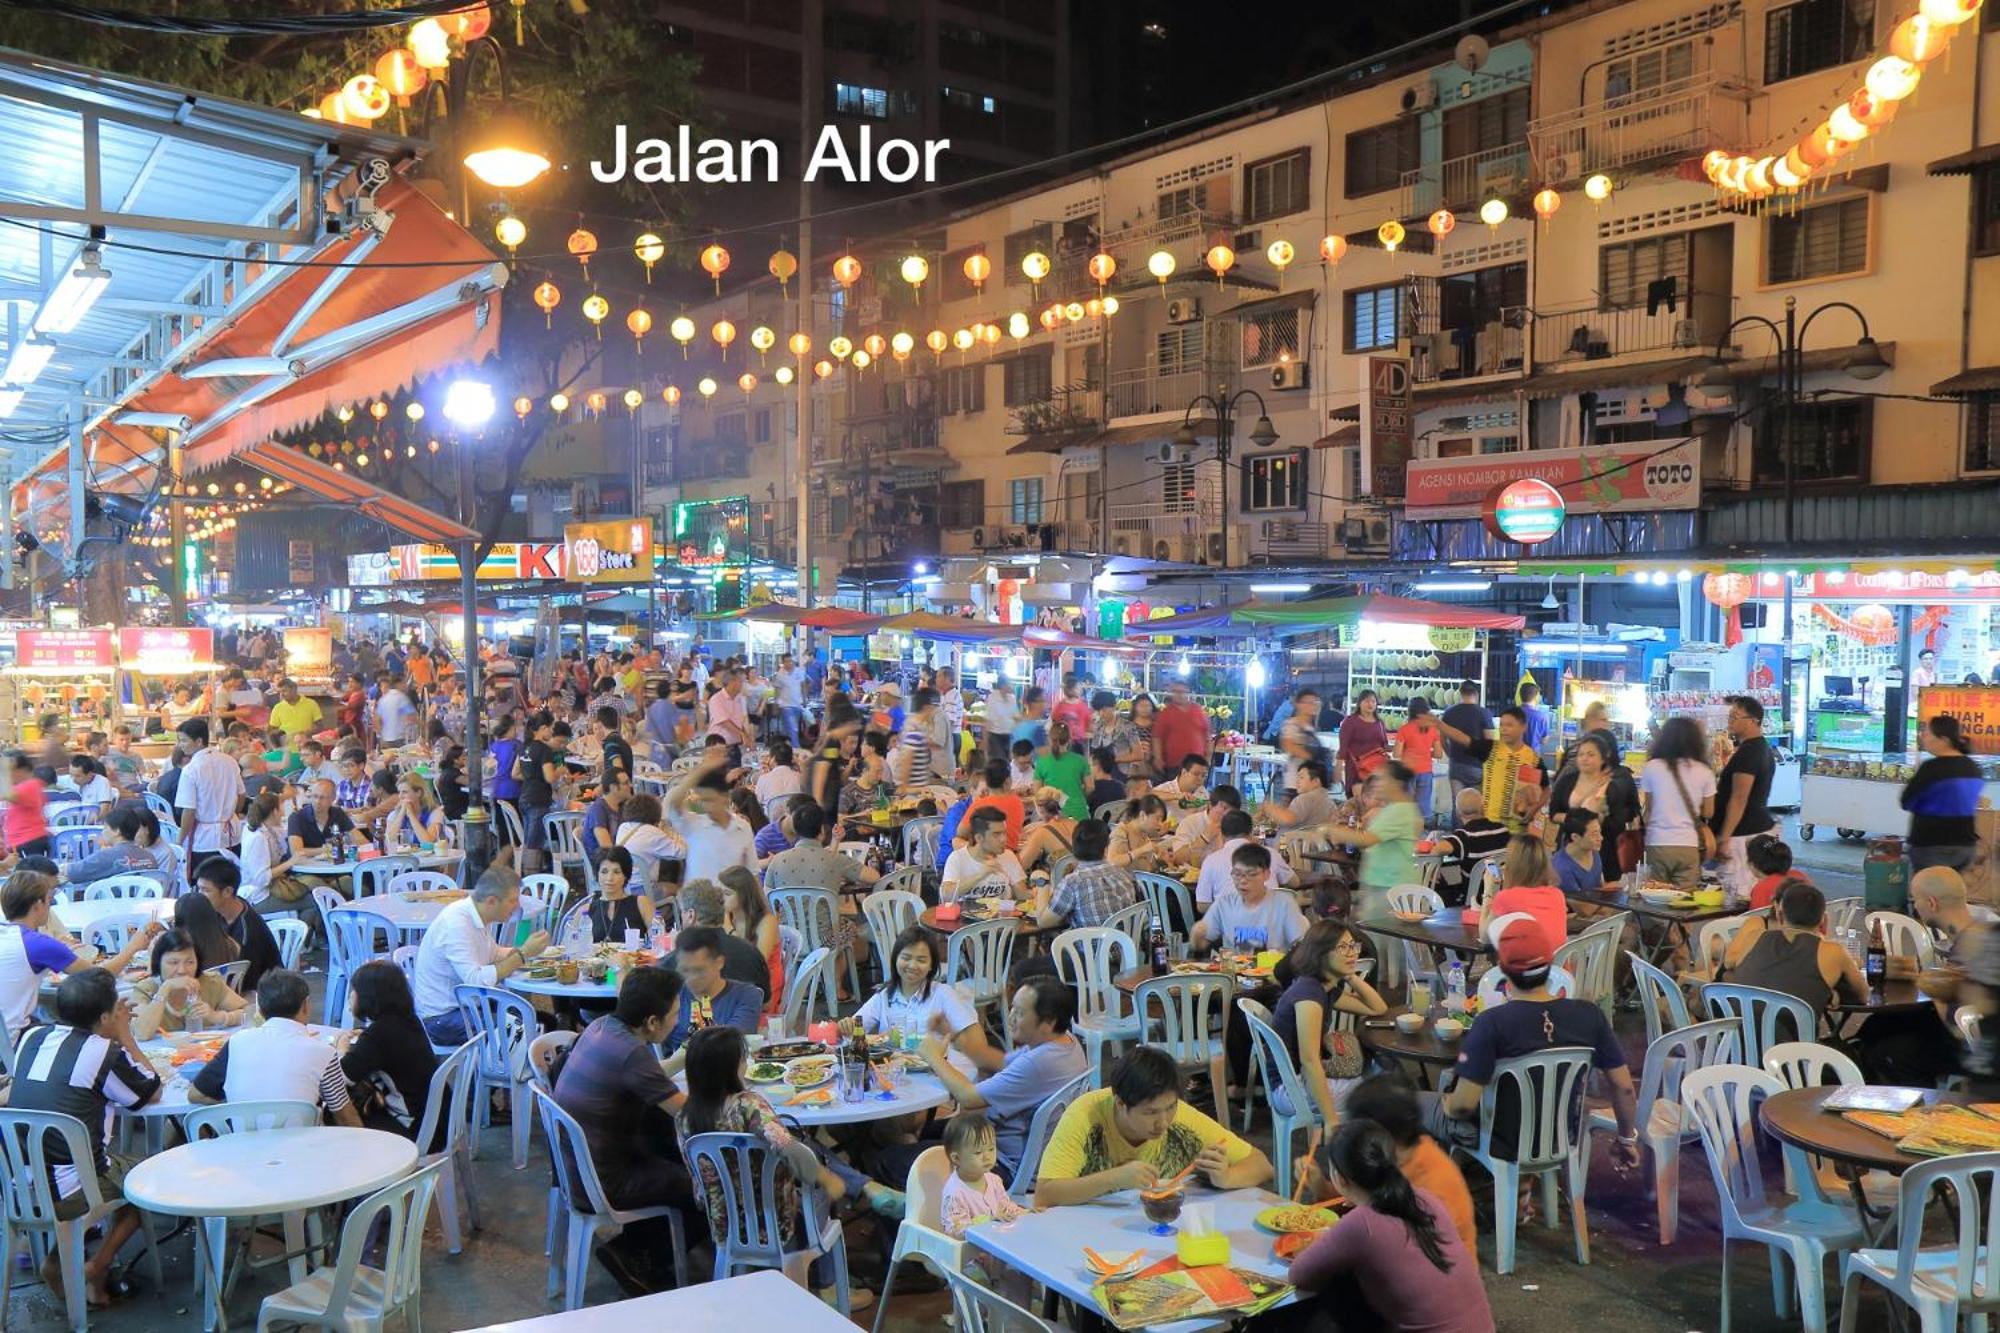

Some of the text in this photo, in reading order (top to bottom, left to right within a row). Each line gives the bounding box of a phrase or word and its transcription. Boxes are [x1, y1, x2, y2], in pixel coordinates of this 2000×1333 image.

[1376, 362, 1407, 396] 4D
[1418, 473, 1456, 489] AGENSI
[1458, 470, 1506, 486] NOMBOR
[1647, 464, 1692, 485] TOTO
[519, 544, 567, 578] K
[600, 550, 632, 569] Store
